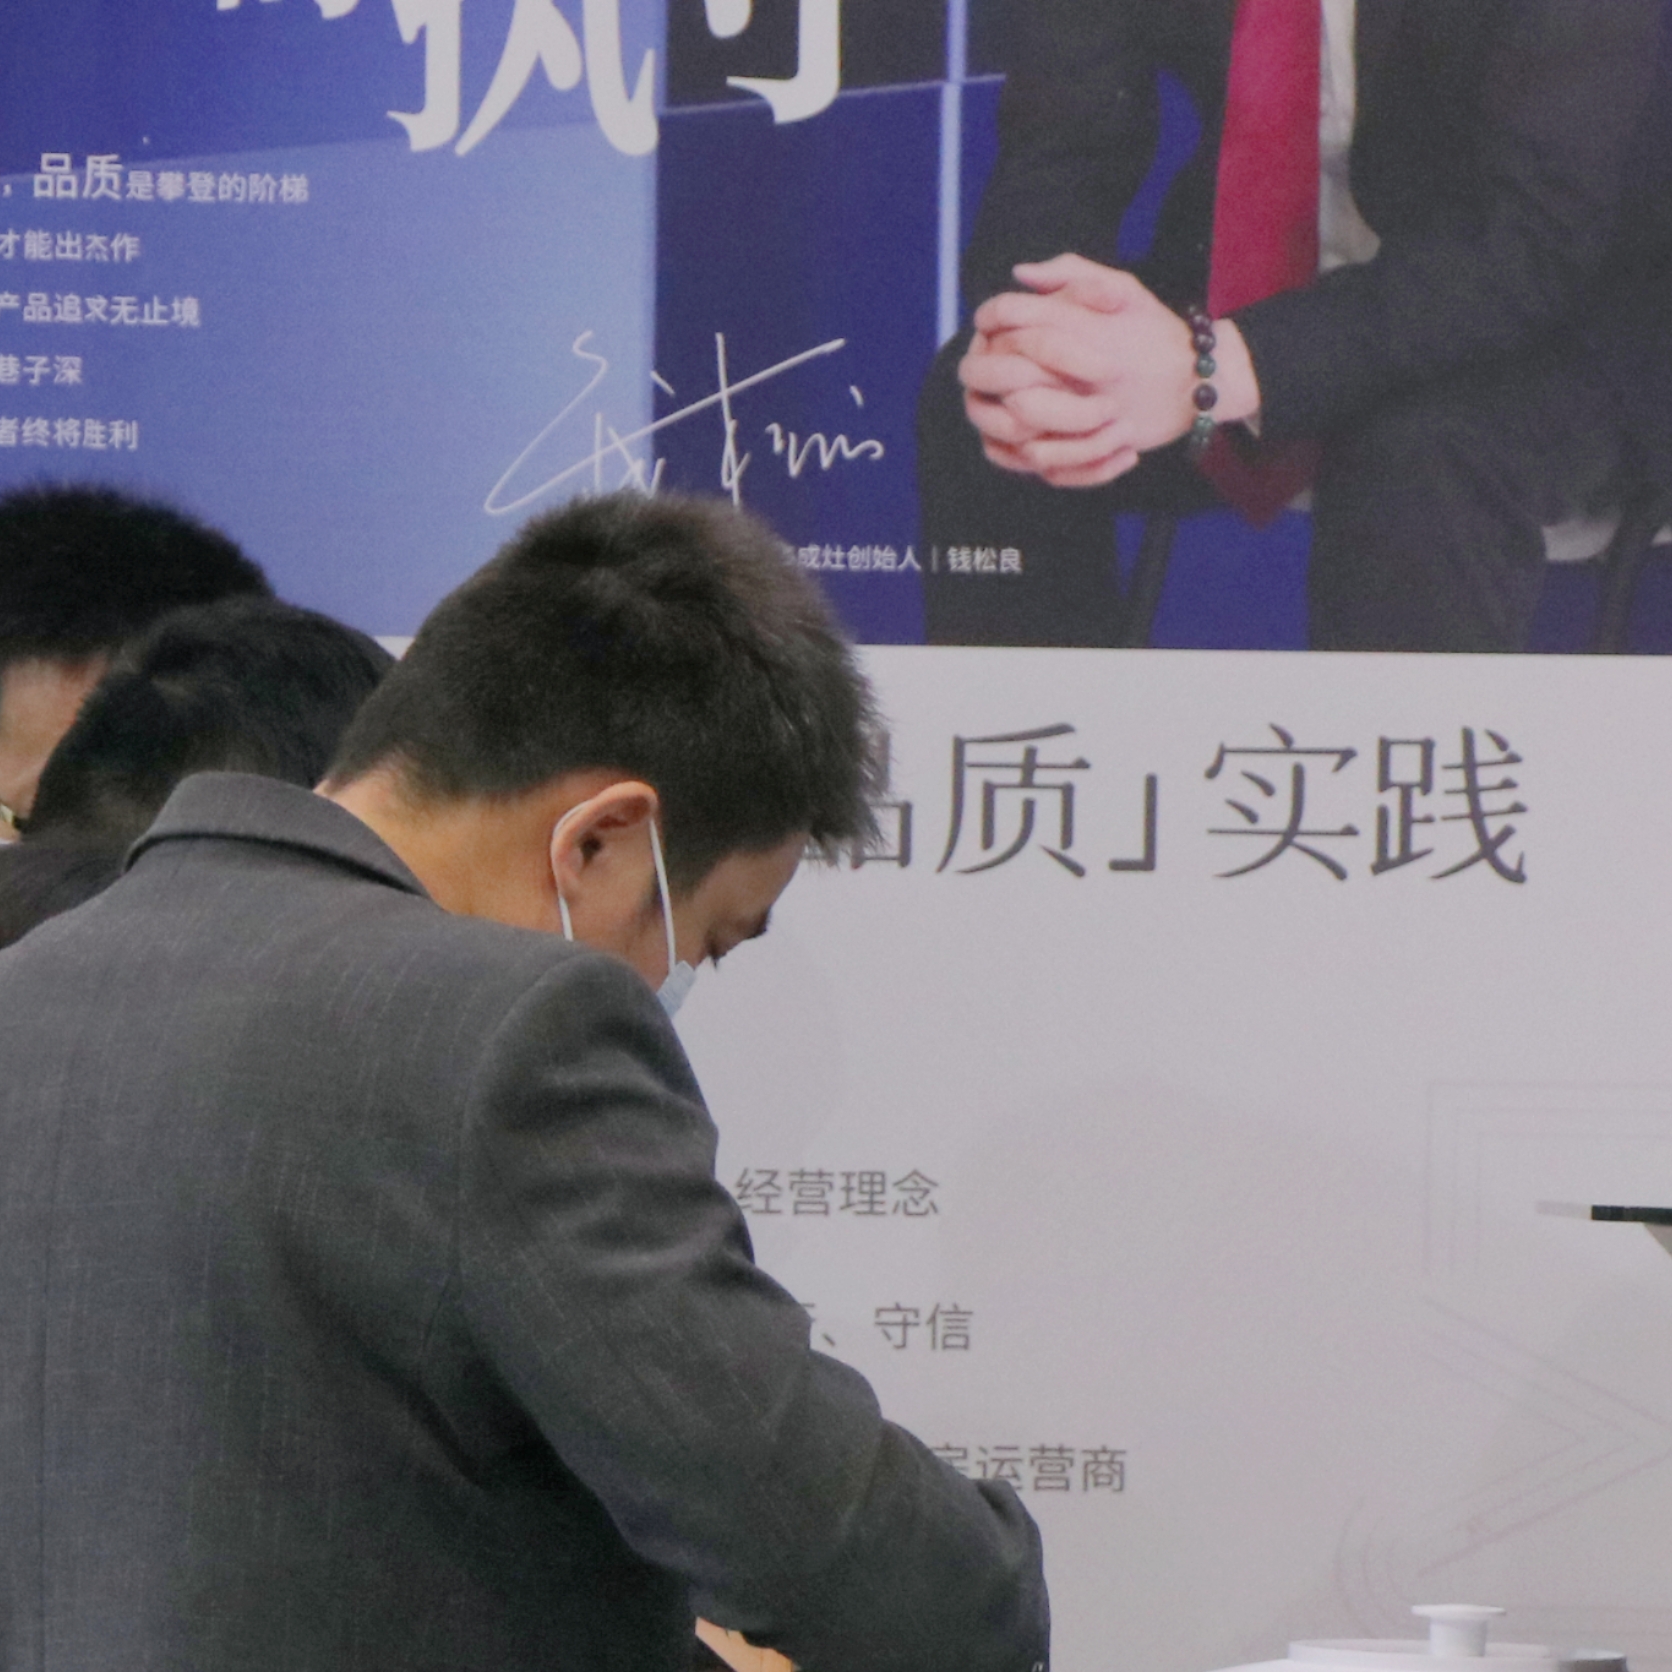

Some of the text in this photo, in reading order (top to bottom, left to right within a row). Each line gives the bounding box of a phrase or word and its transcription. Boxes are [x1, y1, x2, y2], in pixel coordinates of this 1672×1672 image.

[947, 545, 1024, 575] 钱松良
[735, 1168, 940, 1217] 经营理念
